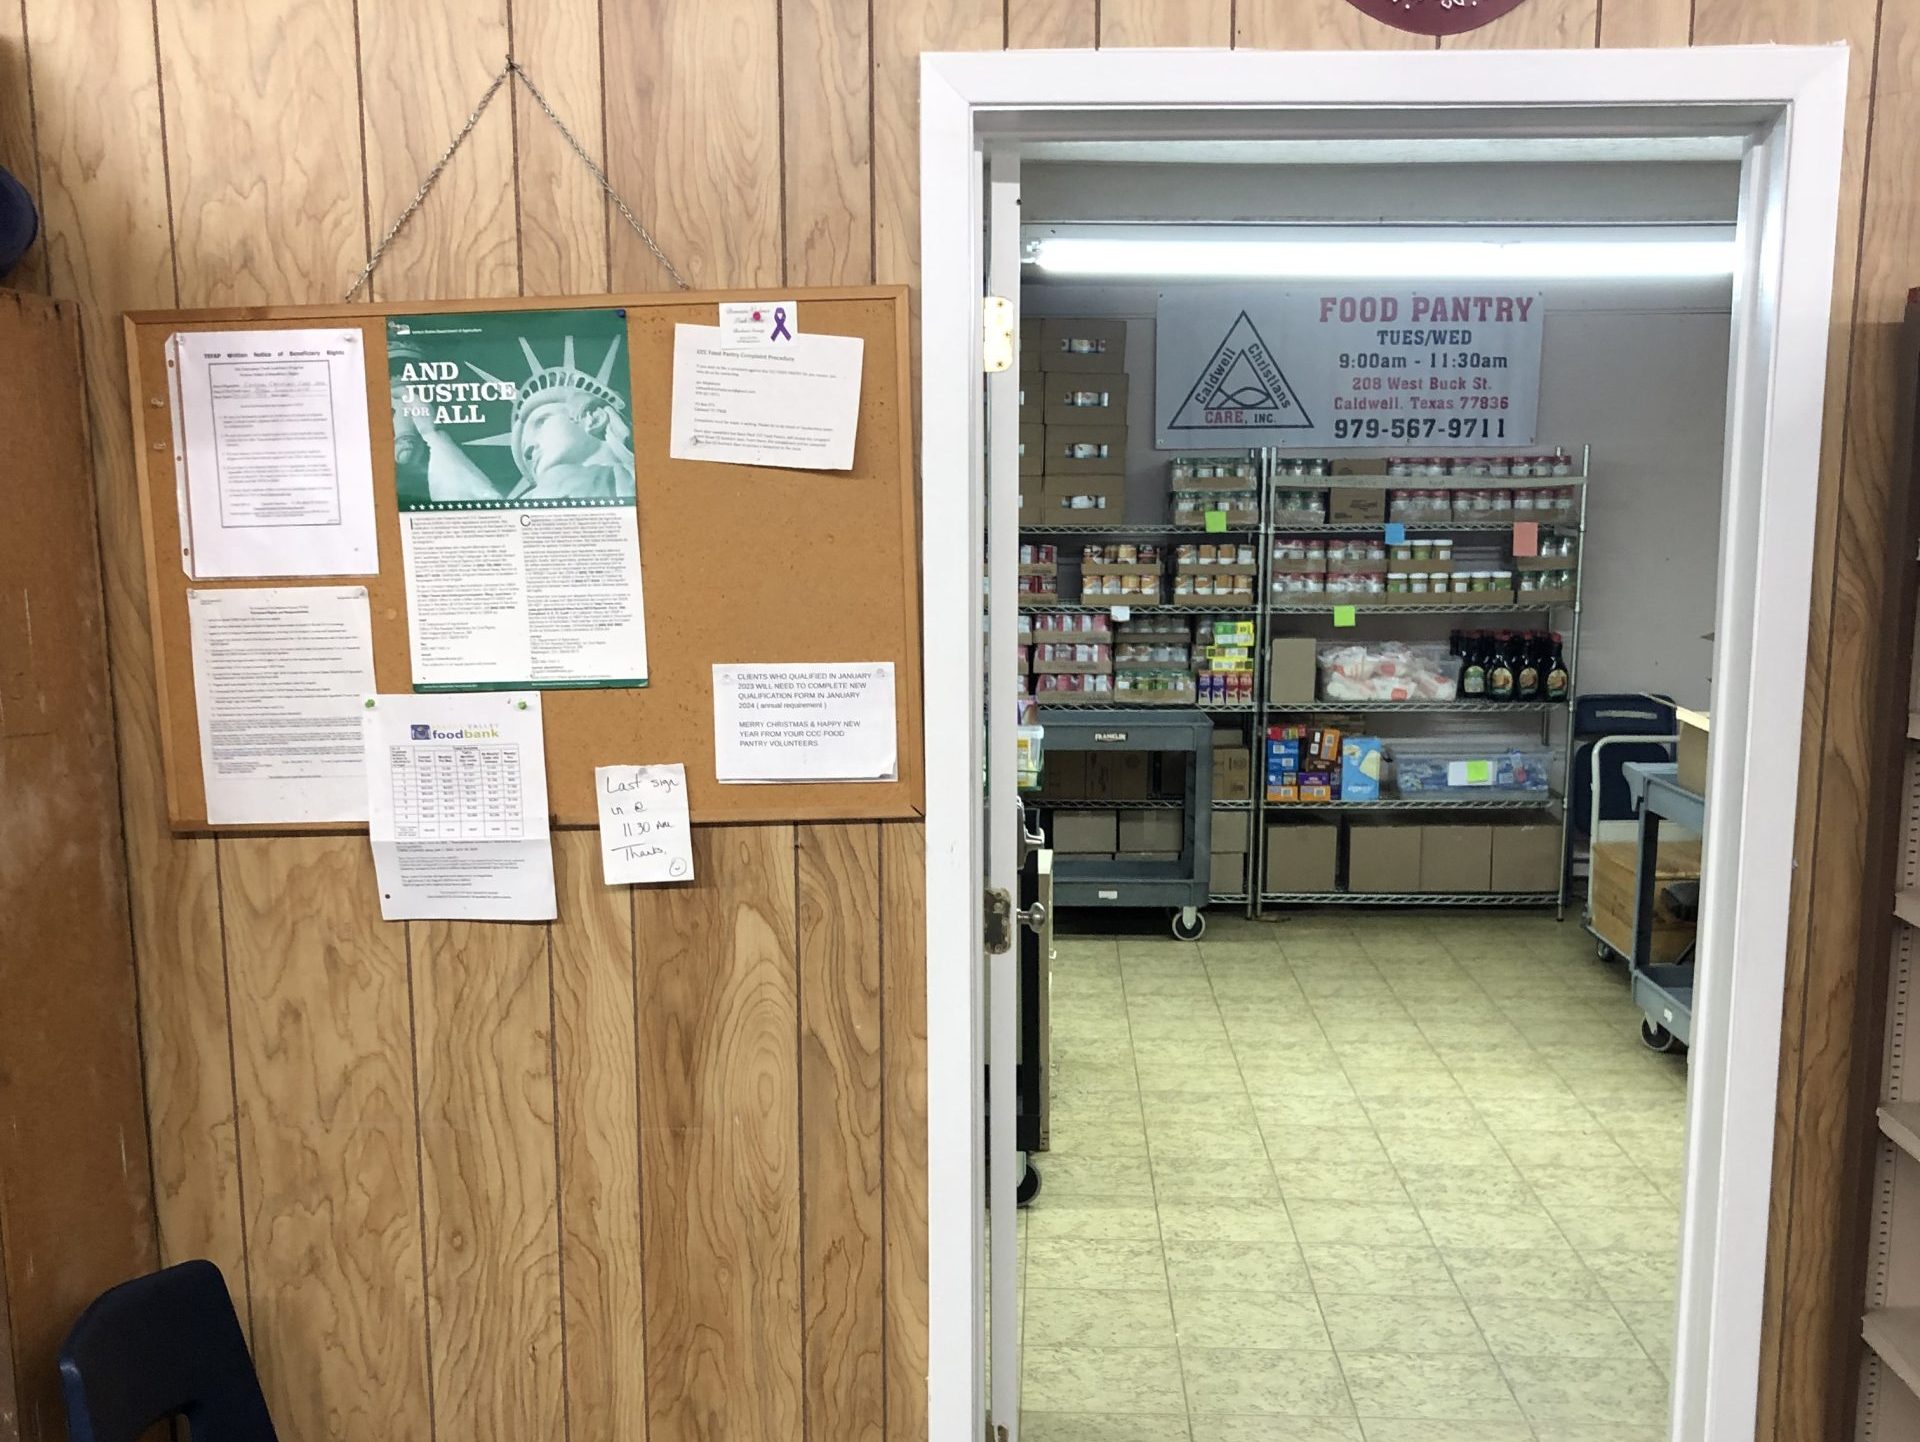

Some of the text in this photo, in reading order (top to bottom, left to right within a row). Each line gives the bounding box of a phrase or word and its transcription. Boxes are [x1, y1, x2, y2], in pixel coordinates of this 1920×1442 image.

[1319, 296, 1534, 323] FOOD PANTRY
[1377, 330, 1472, 346] TUES/WED
[1339, 353, 1407, 369] 9:00am
[1430, 352, 1508, 369] 11:30am
[400, 361, 459, 381] AND
[1194, 347, 1236, 404] Caldwell
[1247, 343, 1291, 409] Christians
[401, 382, 517, 403] JUSTICE
[1352, 377, 1492, 390] 208 West Buck St.
[1410, 397, 1454, 410] Texas
[1460, 397, 1509, 410] 77836
[403, 404, 486, 424] FOR ALL
[1205, 411, 1277, 424] CARE, INC.
[1334, 418, 1505, 439] 979-567-9711
[738, 692, 792, 700] QUALIFICATION
[783, 702, 823, 710] requirement
[606, 773, 681, 794] Last sign
[611, 806, 624, 815] in
